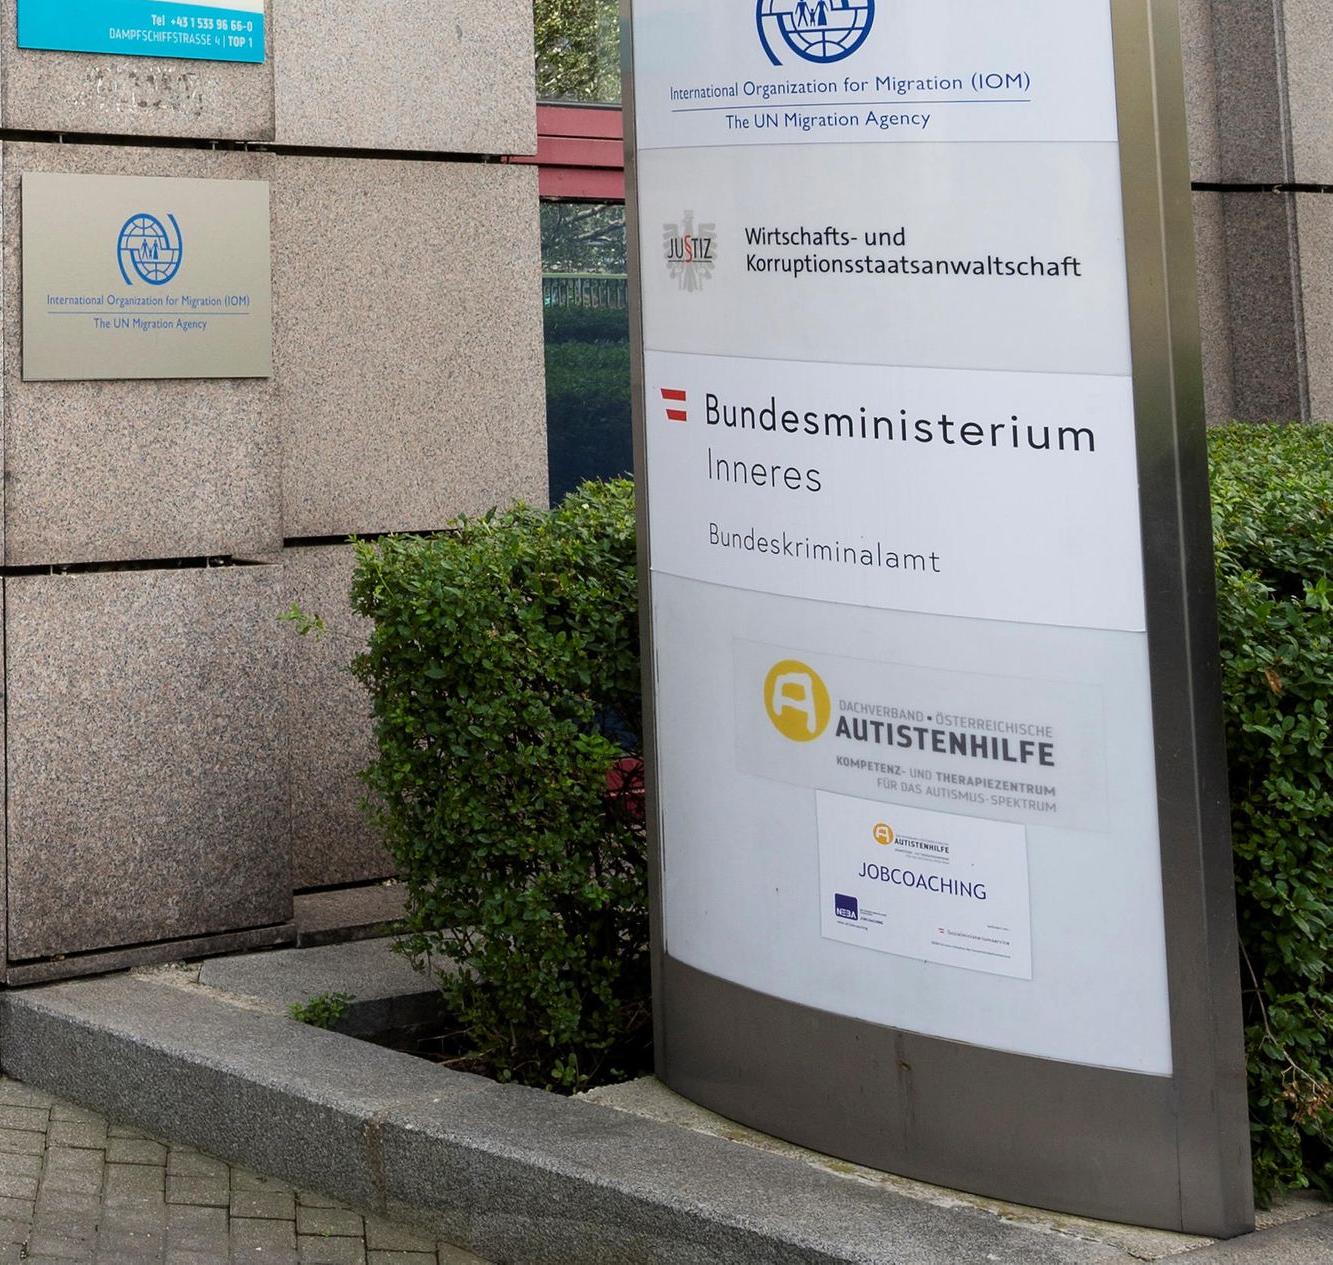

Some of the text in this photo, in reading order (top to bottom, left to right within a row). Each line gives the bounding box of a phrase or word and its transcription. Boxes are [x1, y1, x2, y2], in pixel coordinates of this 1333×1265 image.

[151, 15, 165, 26] Tel
[191, 18, 195, 28] 1
[197, 18, 214, 29] 533
[216, 19, 228, 30] 96
[231, 20, 252, 32] 66-0
[109, 28, 253, 48] DAMPFSCHIFFSTRASSE 4 TOP 1
[670, 72, 1031, 101] International Organization for Migration (IOM)
[726, 110, 931, 132] The UN Migration Agency
[745, 227, 905, 246] Wirtschafts- und
[746, 254, 1082, 278] Korruptionsstaatsanwaltschaft
[47, 295, 249, 308] International Organization for Migration (IOM)
[94, 318, 207, 331] The UN Migration Agency
[705, 393, 1095, 452] Bundesministerium
[708, 448, 821, 492] Inneres
[709, 523, 941, 573] Bundeskriminalamt
[839, 700, 1053, 738] DACHVERBAND ÖSTERREICHISCHE
[835, 716, 1055, 767] AUTISTENHILFE
[836, 756, 1056, 797] KOMPETENZ- UND THERAPIEZENTRUM
[877, 777, 898, 790] FÜR
[901, 781, 922, 794] DAS
[895, 838, 949, 853] AUTISTENHILFE
[858, 862, 986, 900] JOBCOACHING
[837, 908, 856, 919] NEBA
